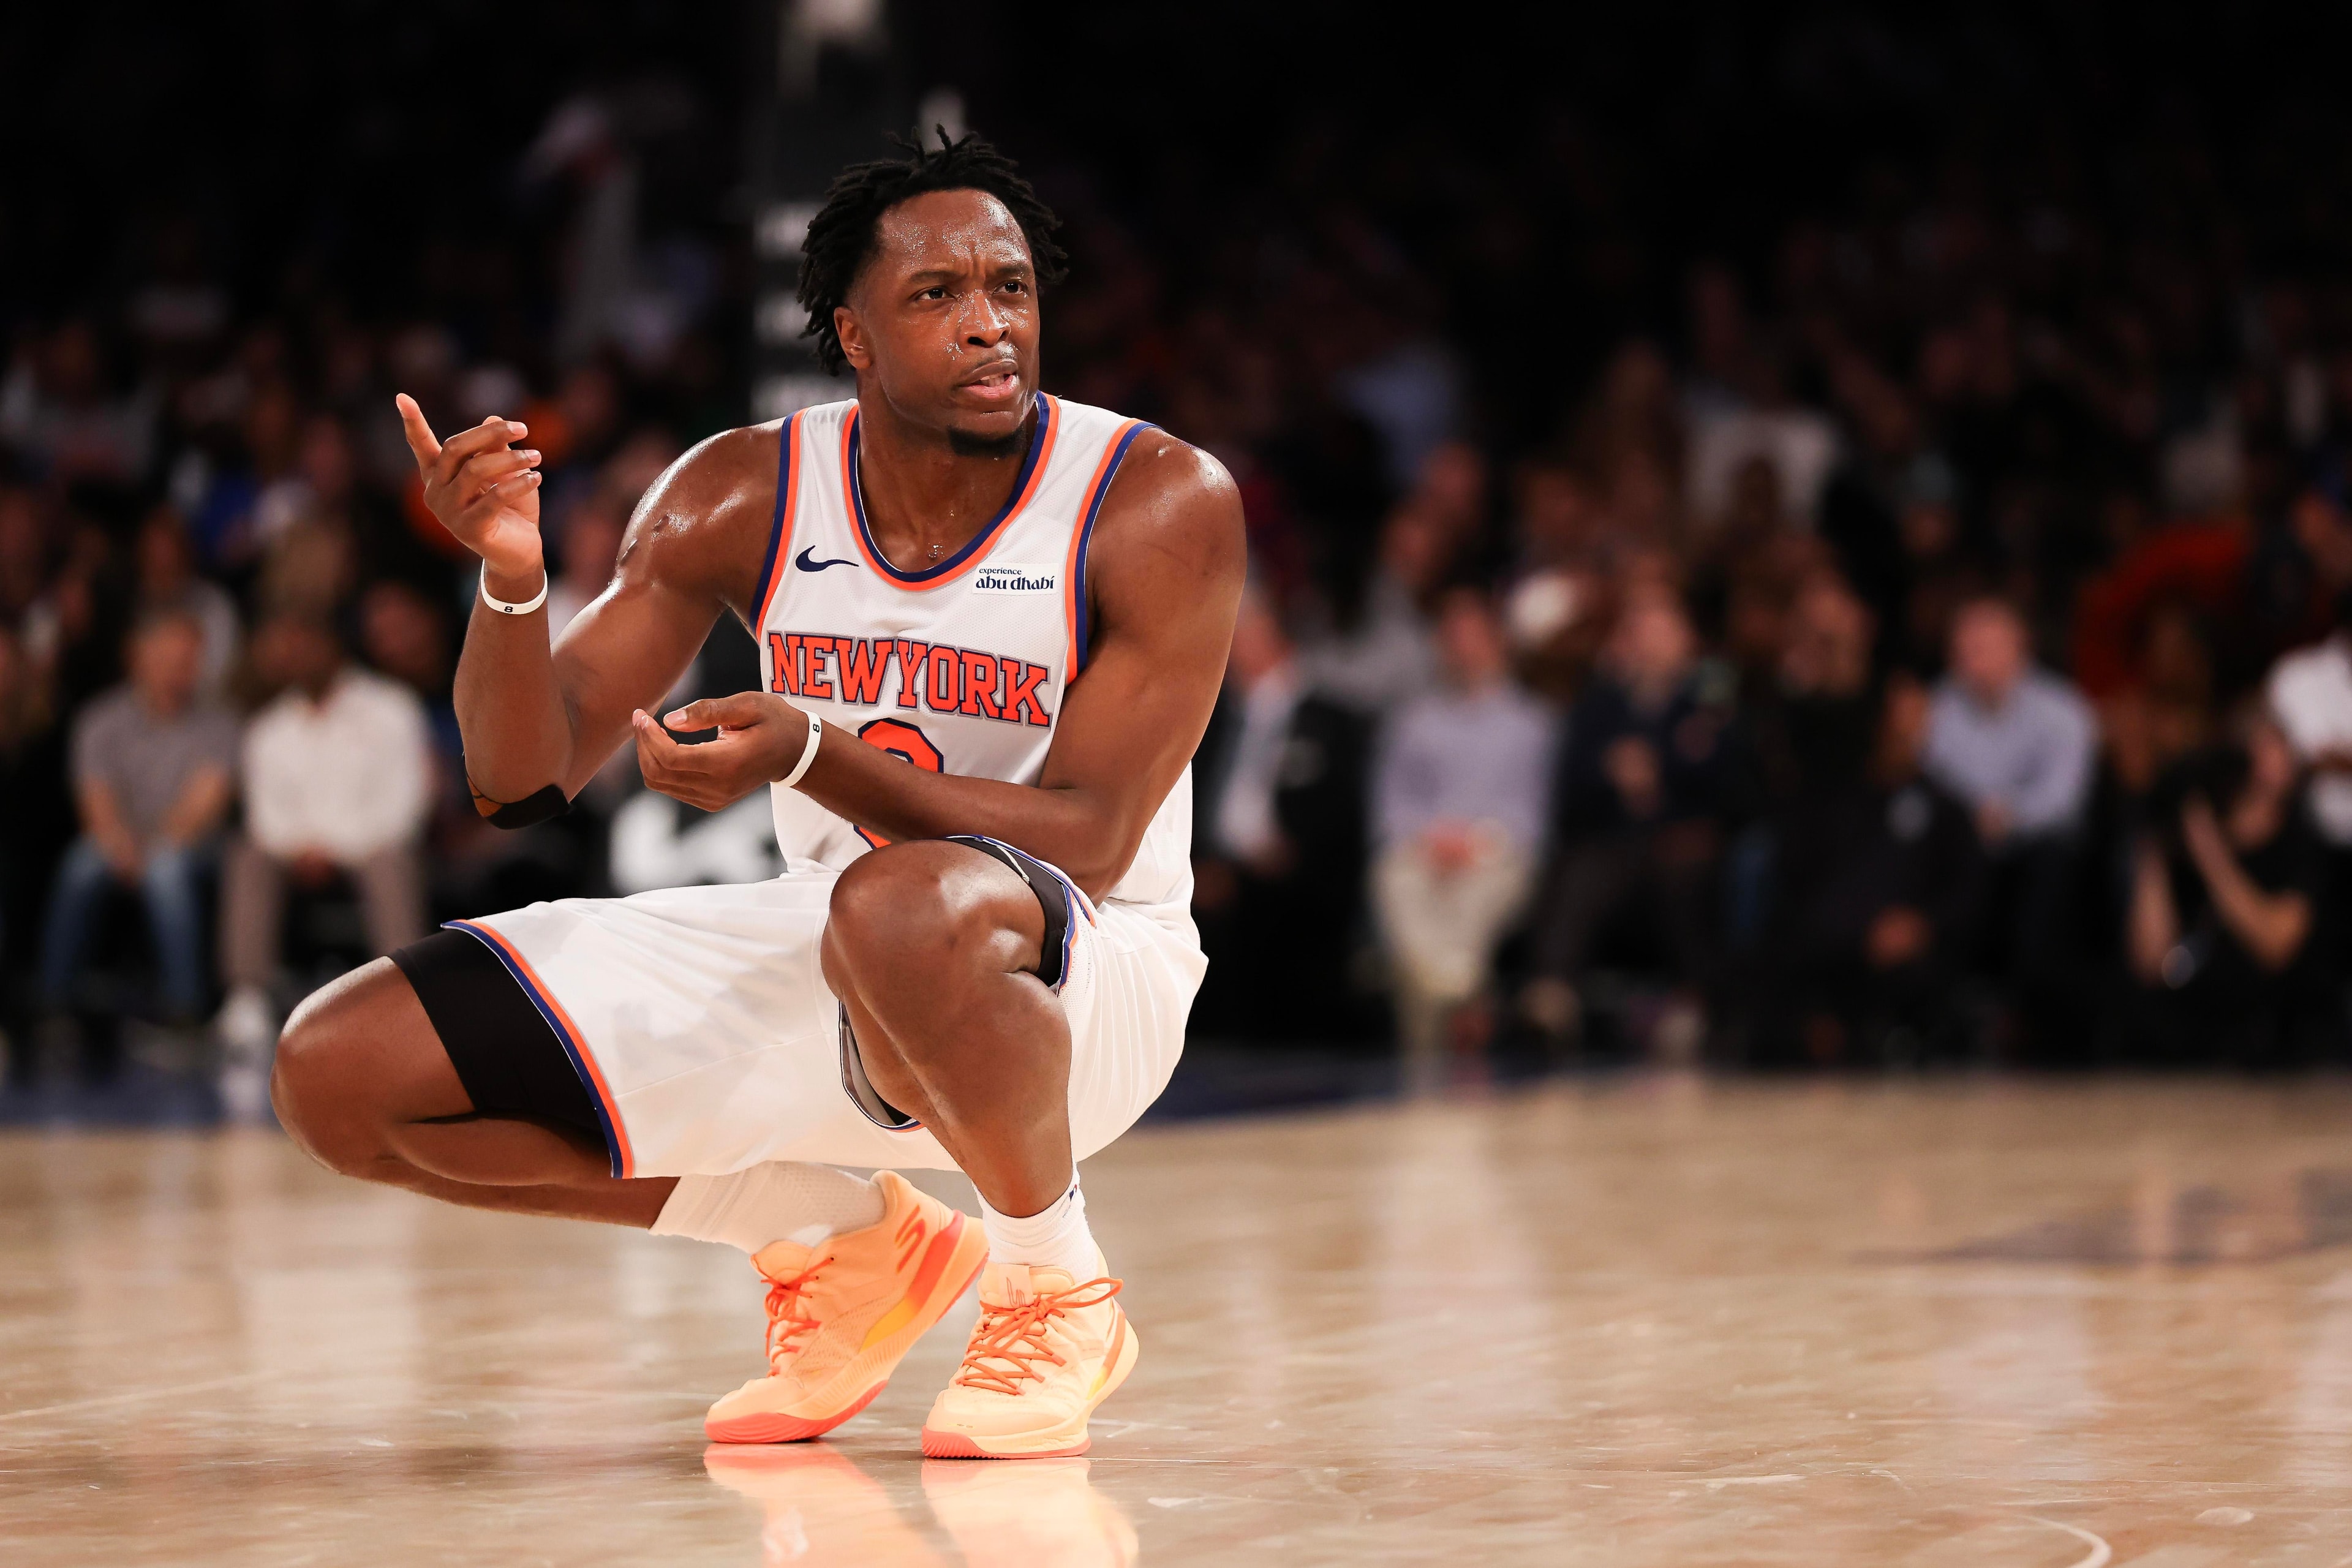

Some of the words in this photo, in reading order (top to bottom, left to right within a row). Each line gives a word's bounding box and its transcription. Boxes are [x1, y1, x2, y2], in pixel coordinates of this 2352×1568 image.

[976, 575, 1007, 590] abu
[767, 631, 895, 706] NEW
[896, 638, 1052, 728] YORK
